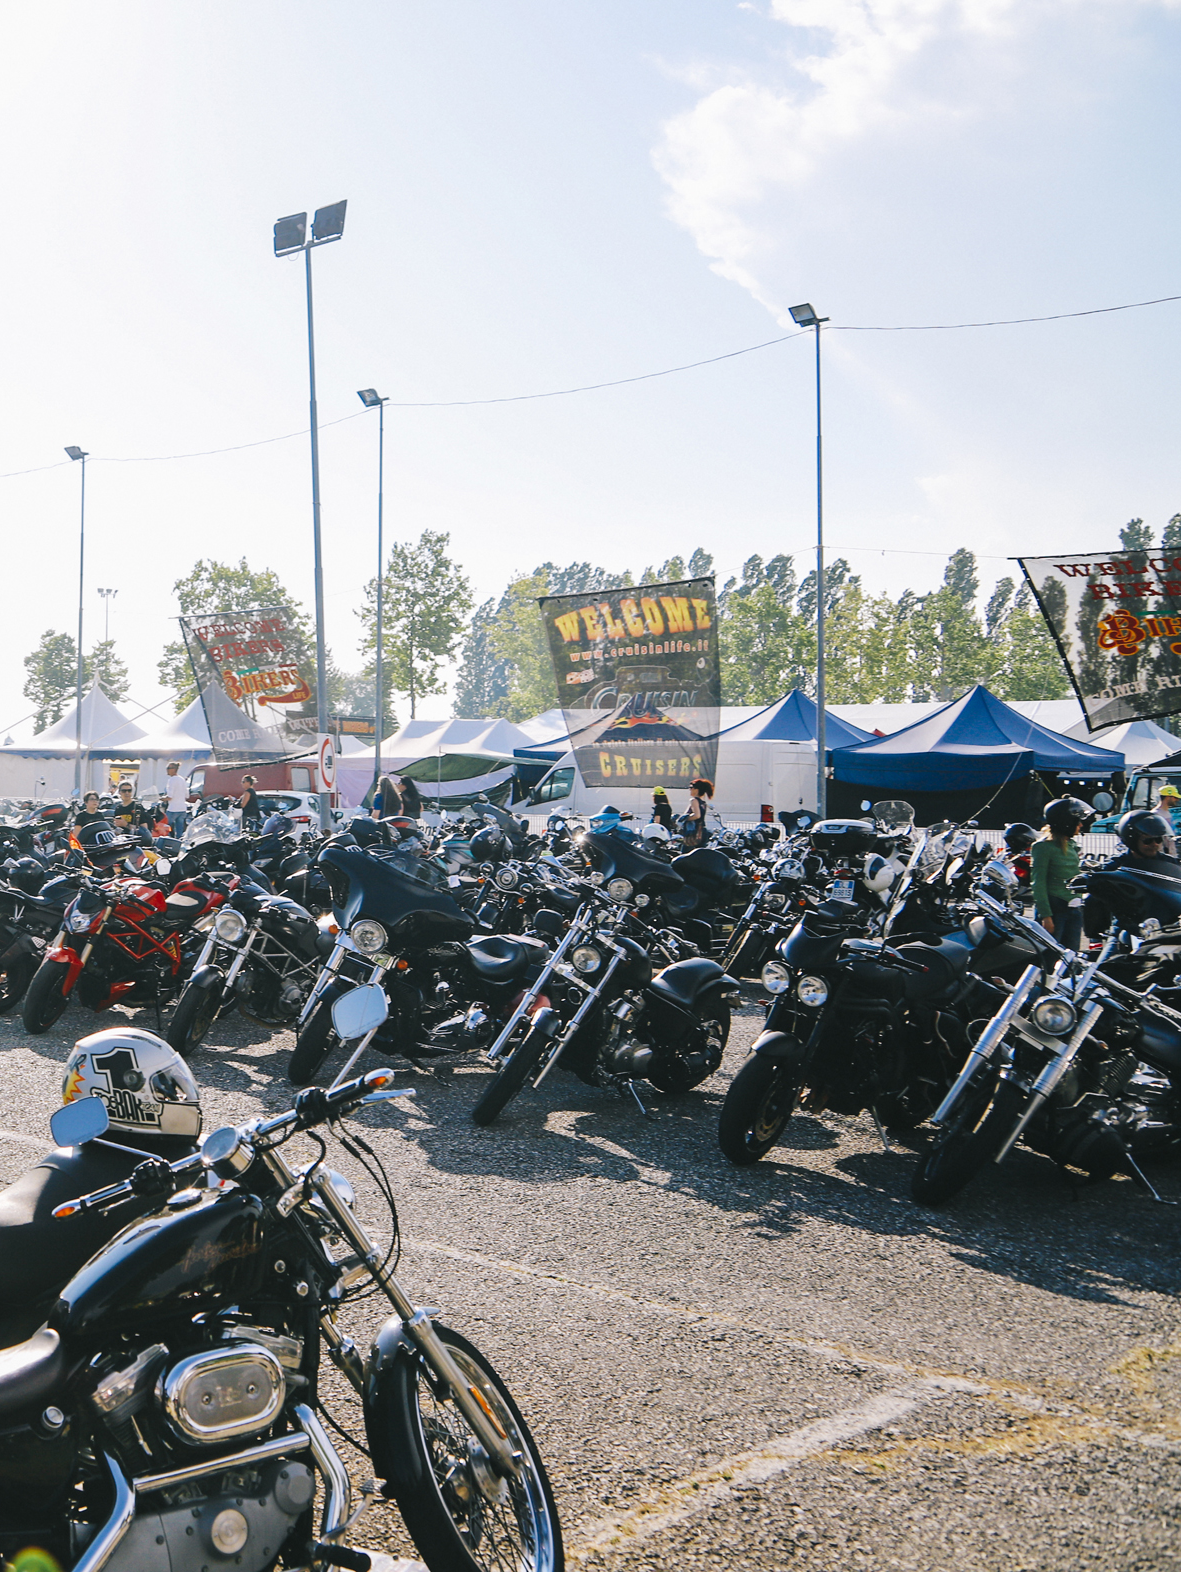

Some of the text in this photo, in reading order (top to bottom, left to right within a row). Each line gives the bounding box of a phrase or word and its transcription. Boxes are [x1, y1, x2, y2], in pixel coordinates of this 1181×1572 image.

[192, 618, 286, 642] WELCOME
[554, 595, 712, 643] WELCOME
[208, 638, 285, 663] BIKERS
[570, 640, 709, 662] www.cruisinlife.it
[292, 691, 307, 701] LIFE
[218, 727, 251, 744] COME
[599, 751, 703, 779] CRUISERS
[91, 1047, 139, 1093] 1
